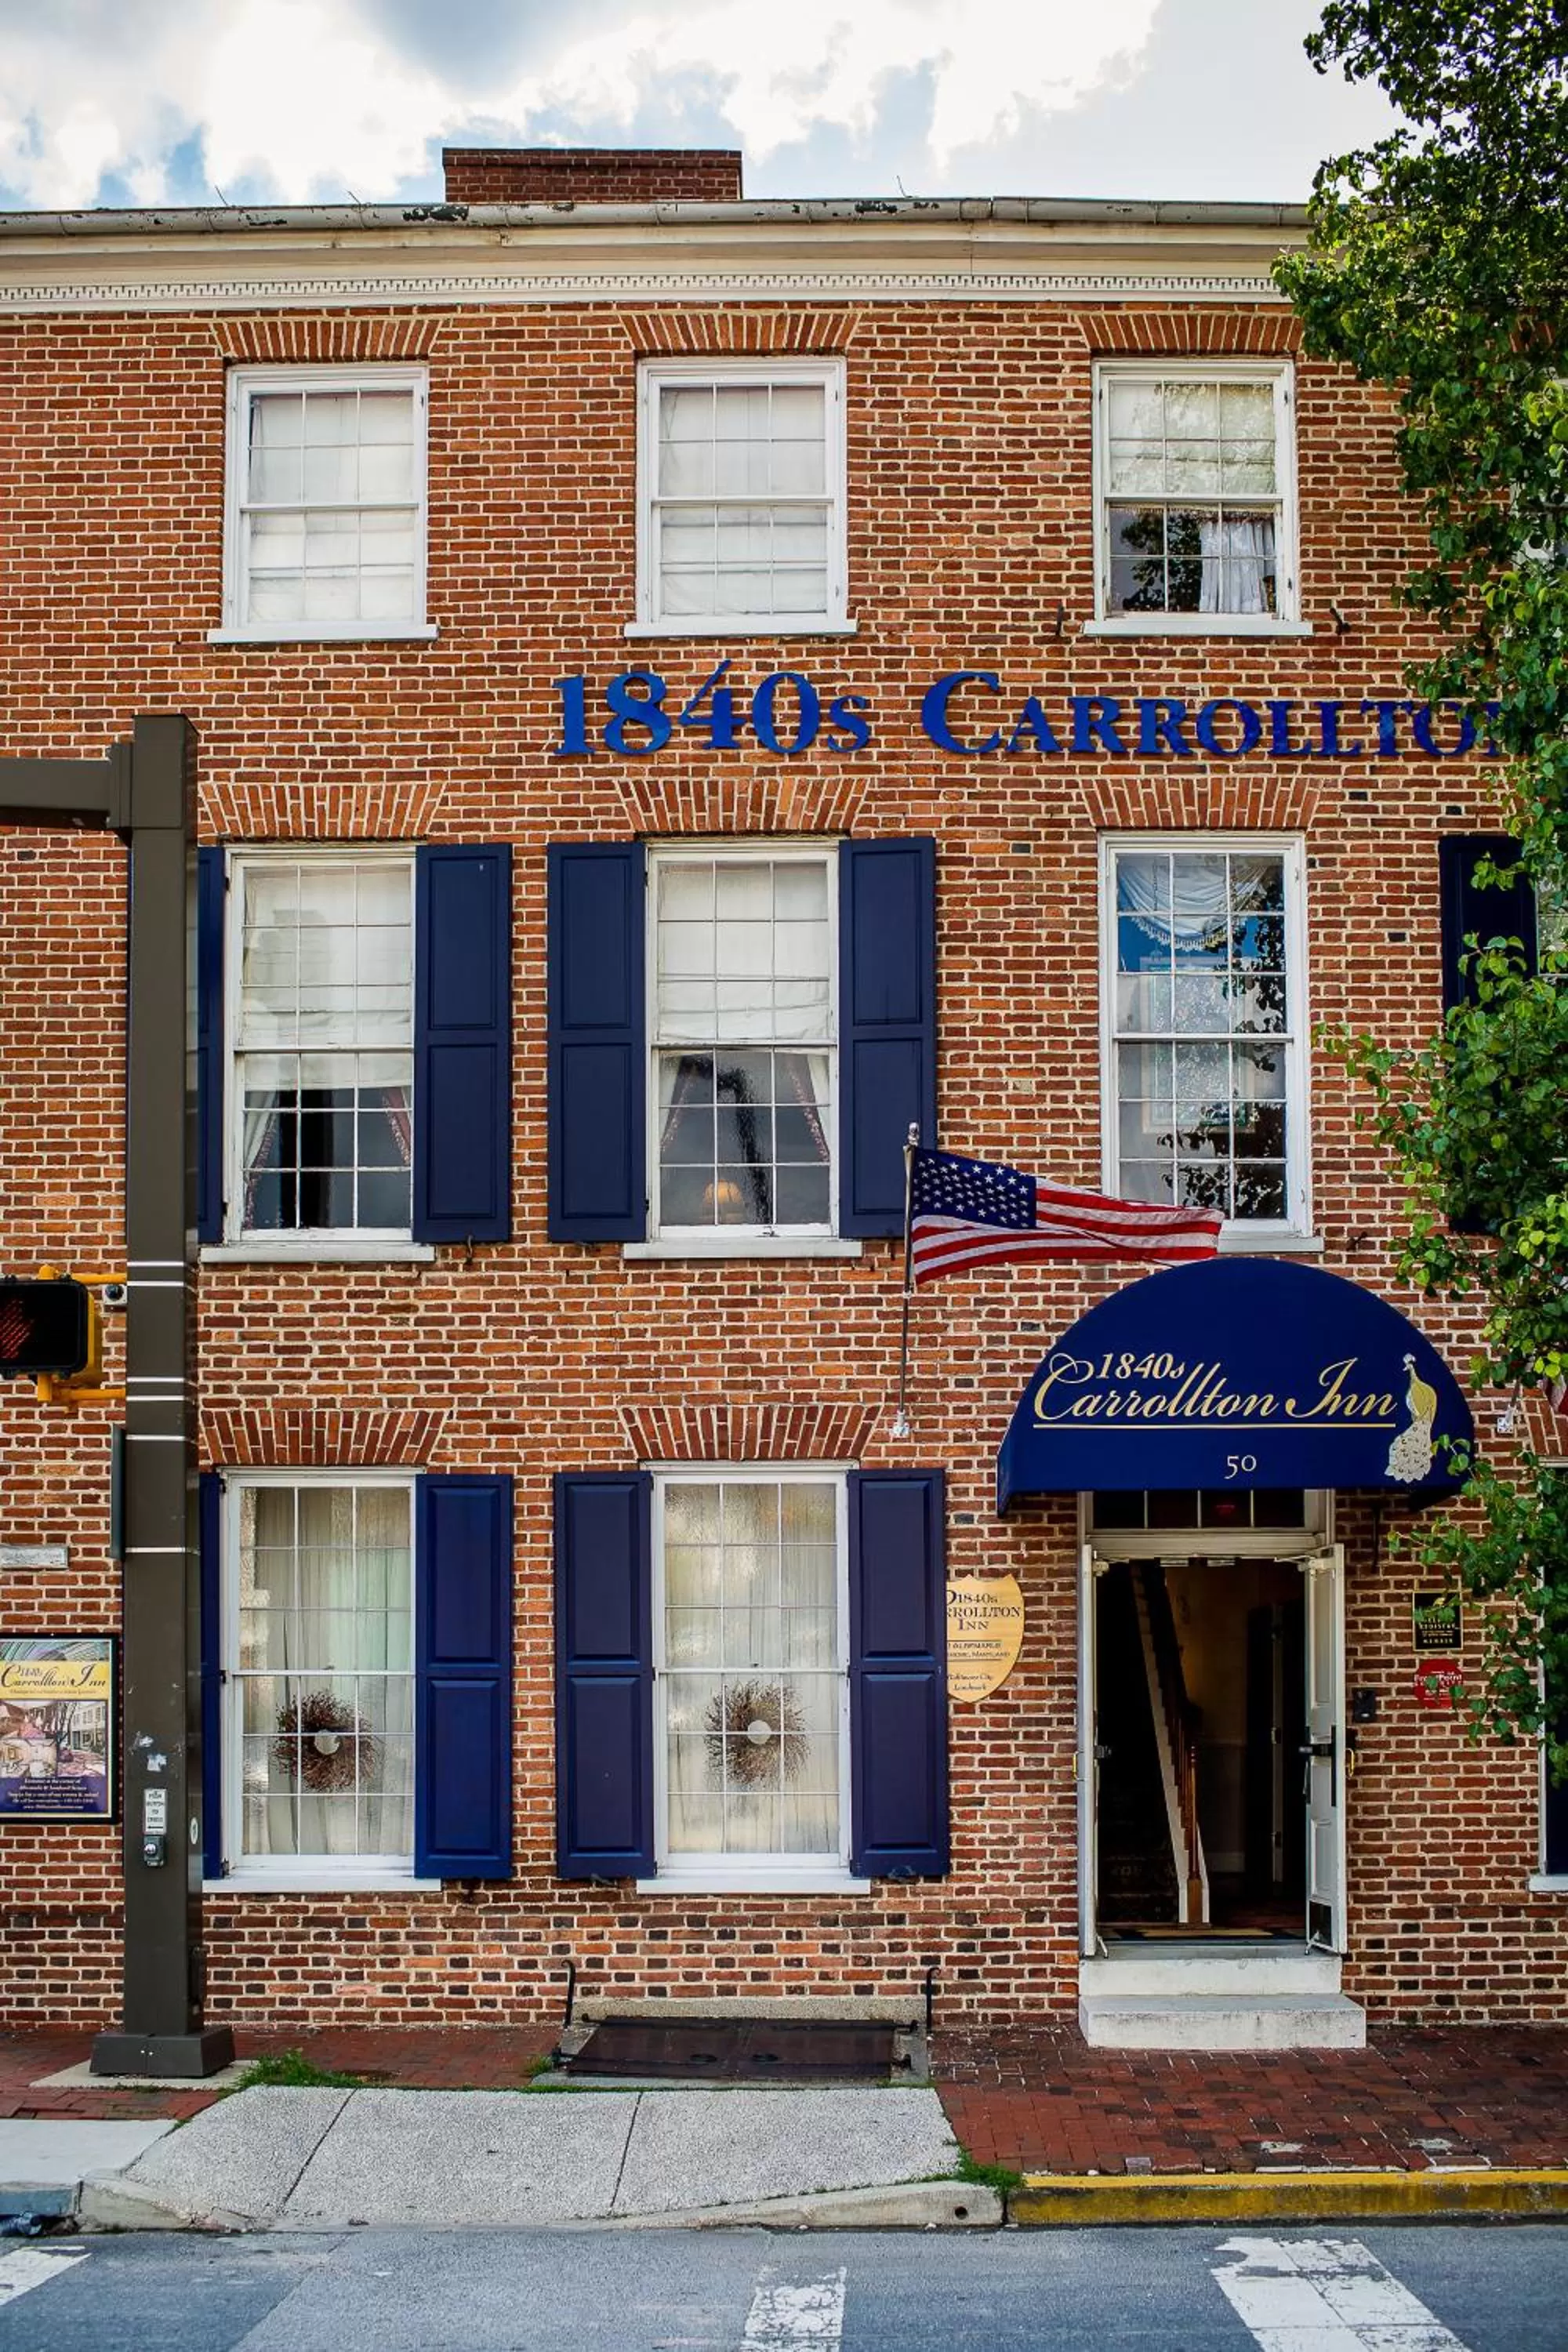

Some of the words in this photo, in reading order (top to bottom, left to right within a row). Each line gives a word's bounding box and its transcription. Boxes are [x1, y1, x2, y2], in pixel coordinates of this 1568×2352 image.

[1095, 1352, 1185, 1379] 1840s
[1034, 1352, 1279, 1420] Carrollton
[1285, 1357, 1398, 1418] Inn
[1224, 1454, 1257, 1479] 50
[71, 1663, 106, 1687] Inn
